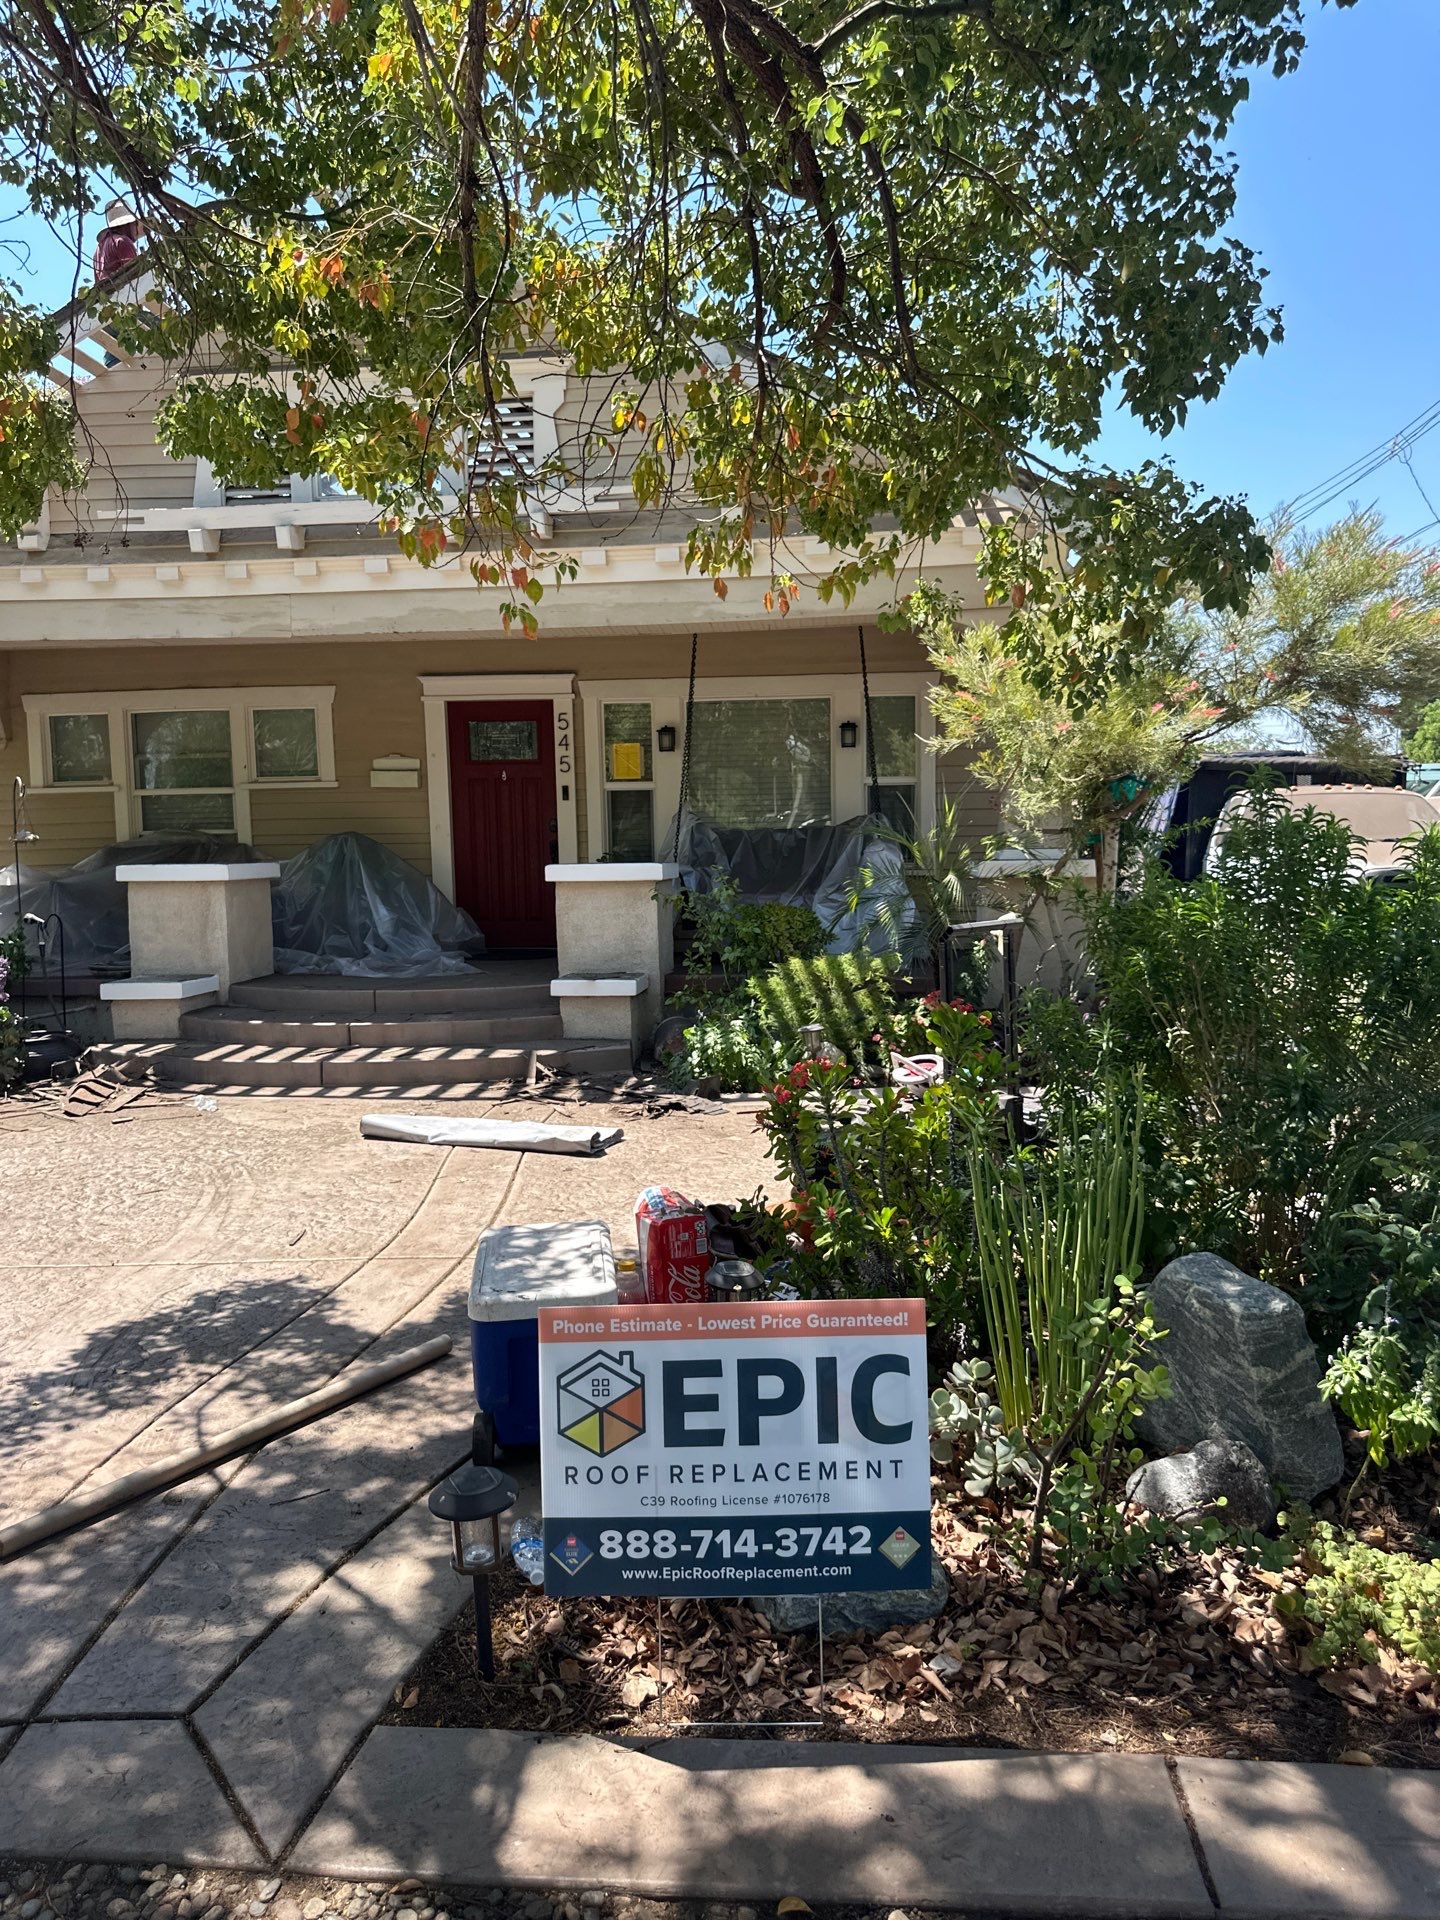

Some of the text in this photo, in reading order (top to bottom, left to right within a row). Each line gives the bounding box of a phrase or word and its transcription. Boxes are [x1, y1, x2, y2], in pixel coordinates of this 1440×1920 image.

[557, 712, 571, 773] 545
[552, 1319, 605, 1334] Phone
[610, 1318, 683, 1333] Estimate
[698, 1316, 756, 1331] Lowest
[761, 1314, 801, 1329] Price
[806, 1311, 909, 1328] Guaranteed!
[662, 1353, 913, 1448] EPIC
[564, 1459, 903, 1485] ROOF REPLACEMENT
[640, 1492, 831, 1508] C39 Roofing License #1076178
[599, 1524, 872, 1560] 888-714-3742
[621, 1565, 852, 1582] www.EpicRoofReplacement.com
